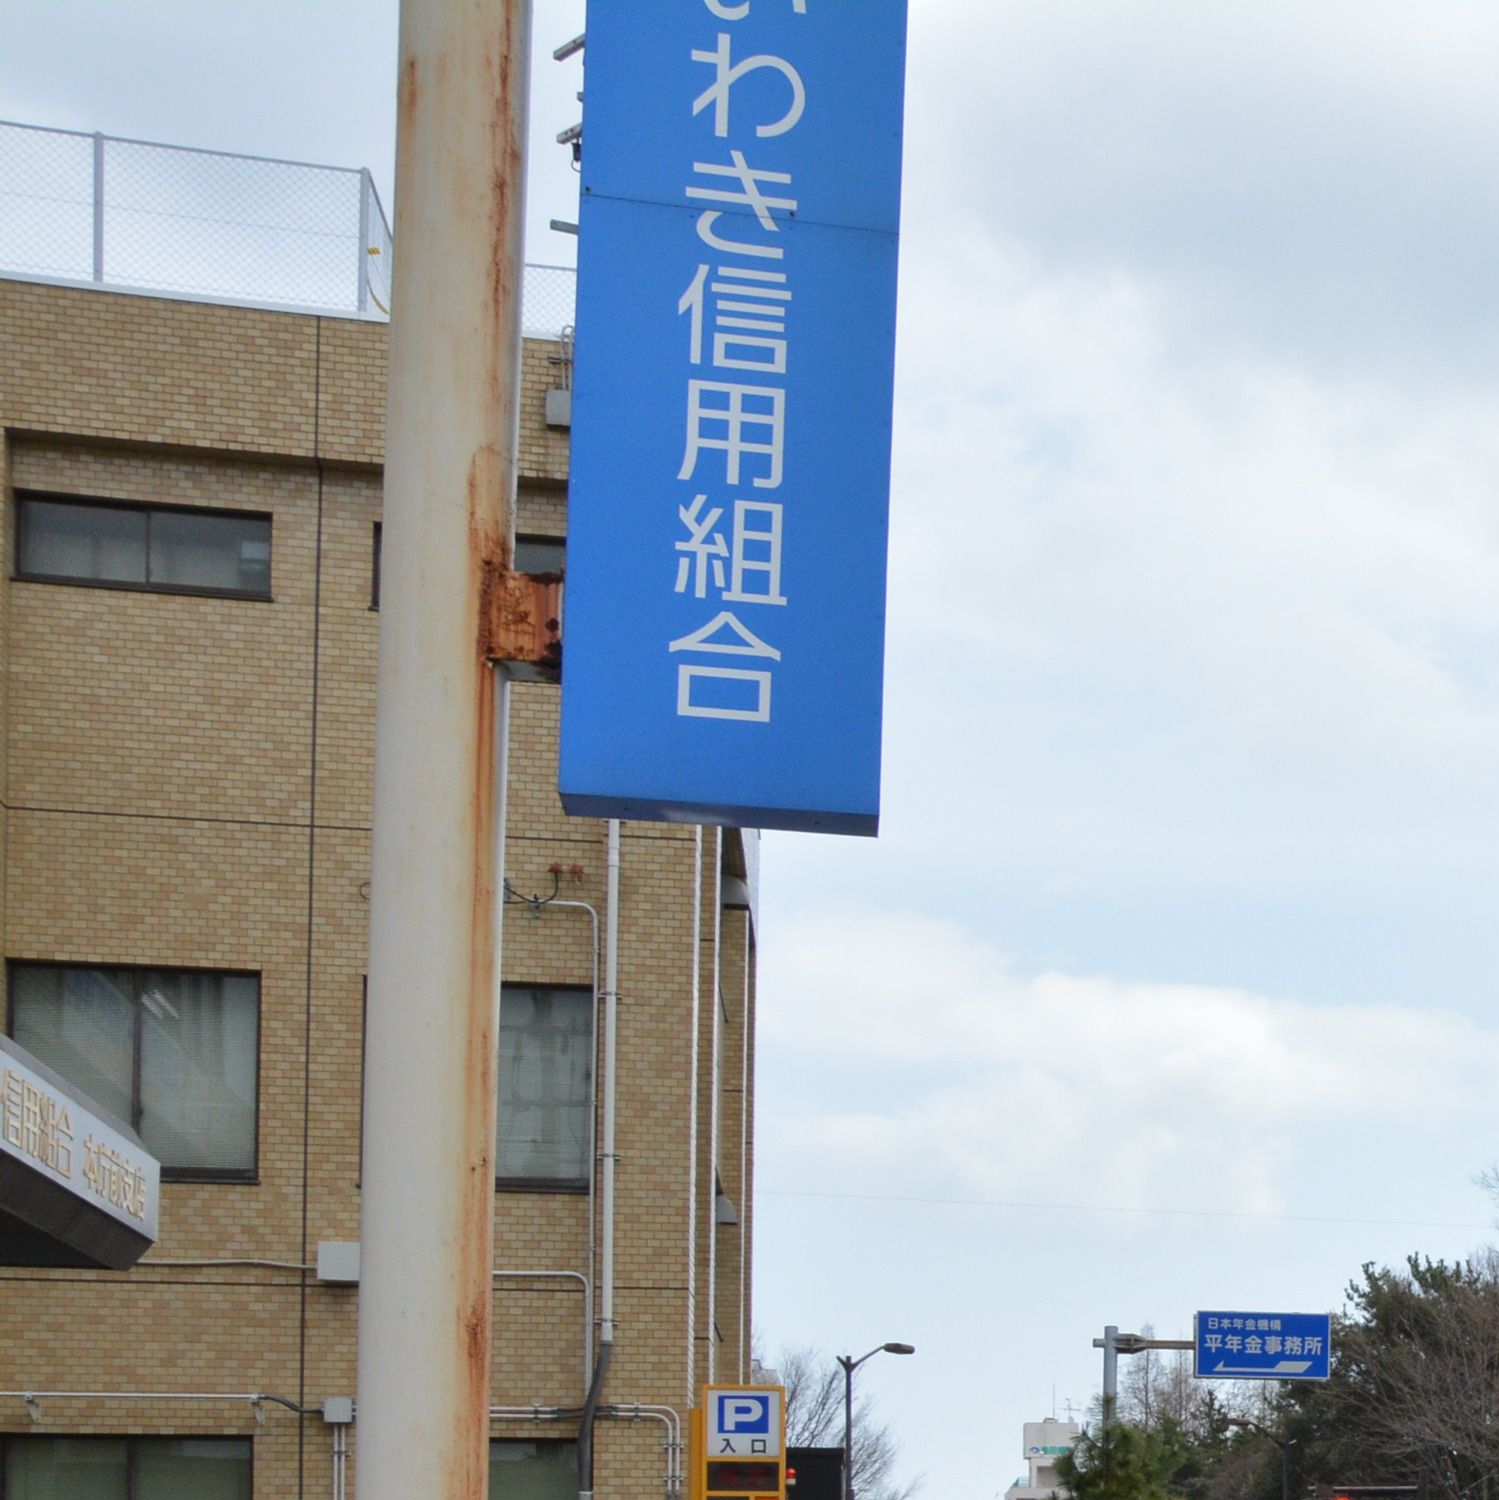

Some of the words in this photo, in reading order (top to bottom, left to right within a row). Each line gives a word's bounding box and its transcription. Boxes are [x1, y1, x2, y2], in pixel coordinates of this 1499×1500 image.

[667, 0, 807, 724] わき信用組合
[1207, 1317, 1282, 1331] 日本年金機構
[1204, 1333, 1323, 1356] 平年金事務所
[723, 1398, 764, 1431] P
[720, 1438, 767, 1454] 入口
